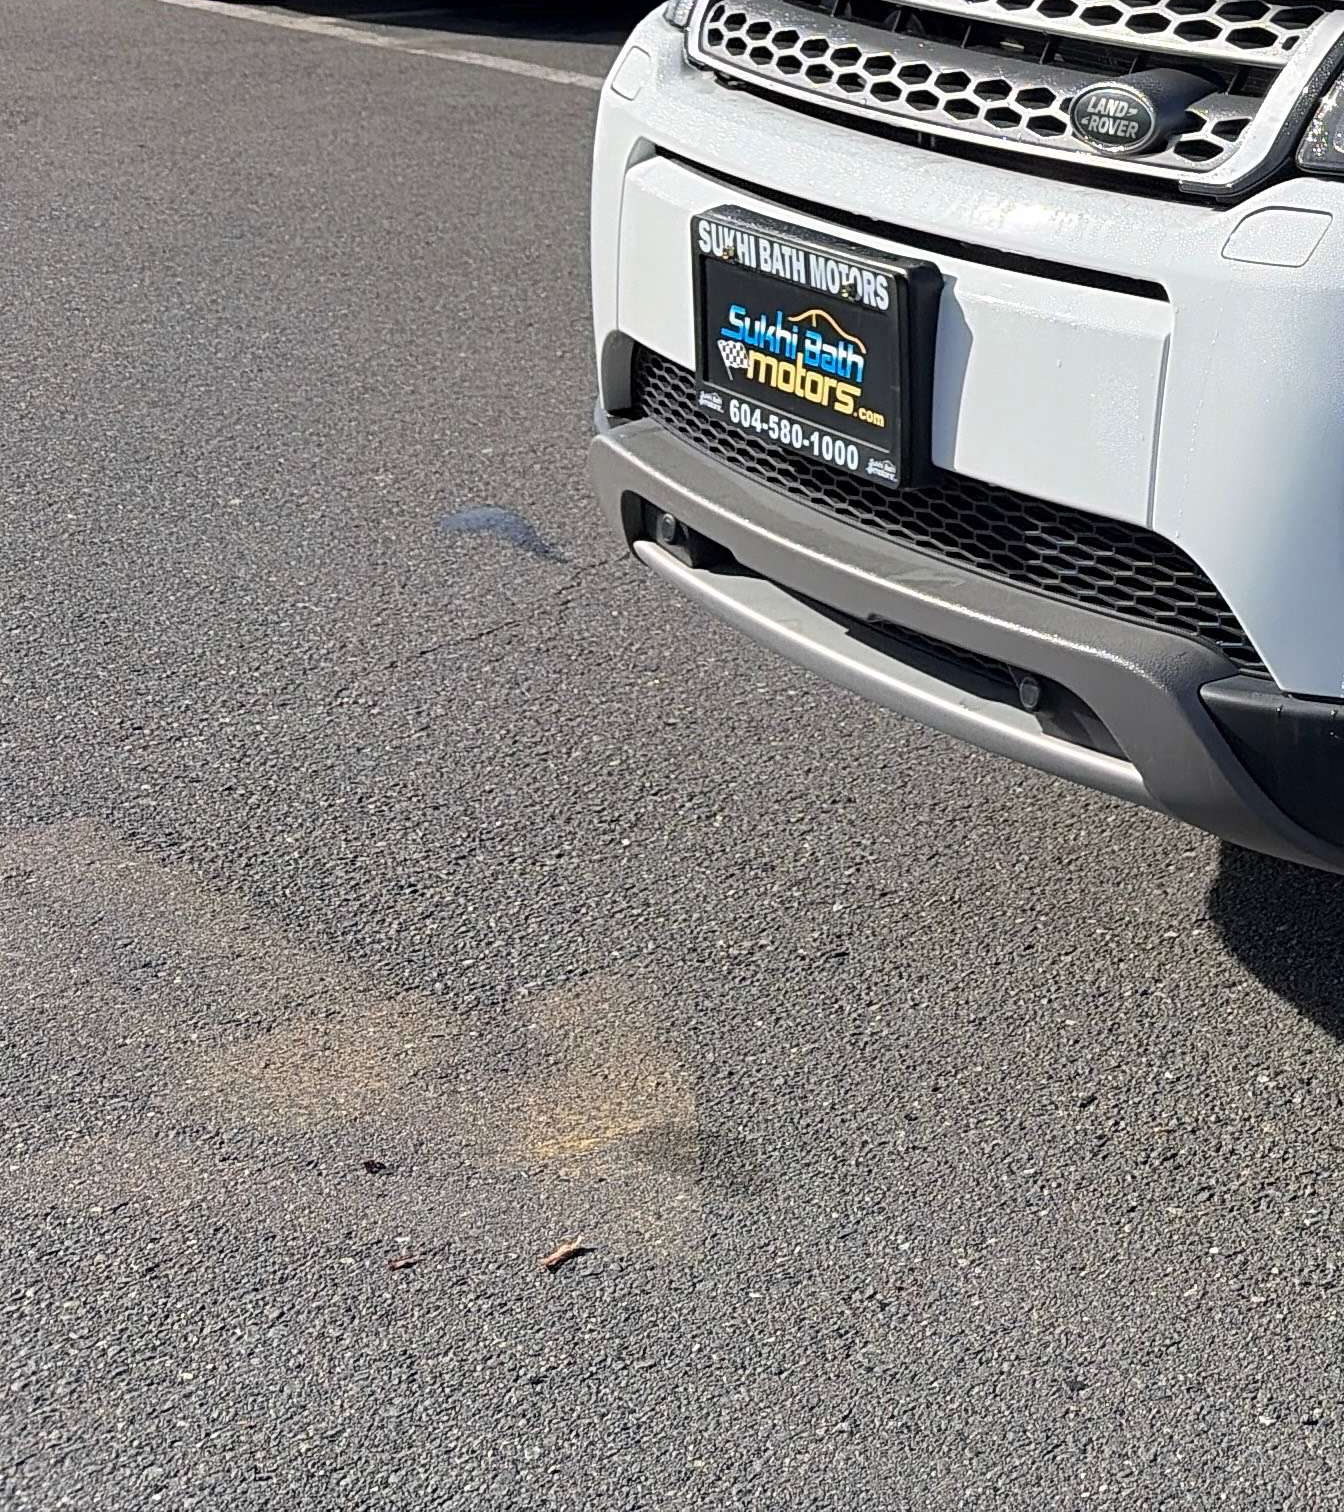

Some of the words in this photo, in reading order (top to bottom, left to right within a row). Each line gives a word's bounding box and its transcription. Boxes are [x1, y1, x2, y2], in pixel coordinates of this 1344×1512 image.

[1087, 96, 1128, 118] LAND
[1088, 115, 1139, 139] ROVER
[698, 220, 757, 269] SUKHI
[759, 237, 806, 284] BATH
[809, 256, 889, 311] MOTORS
[720, 304, 798, 360] Sukhi
[803, 329, 865, 384] Bath
[729, 398, 859, 471] 604-580-1000
